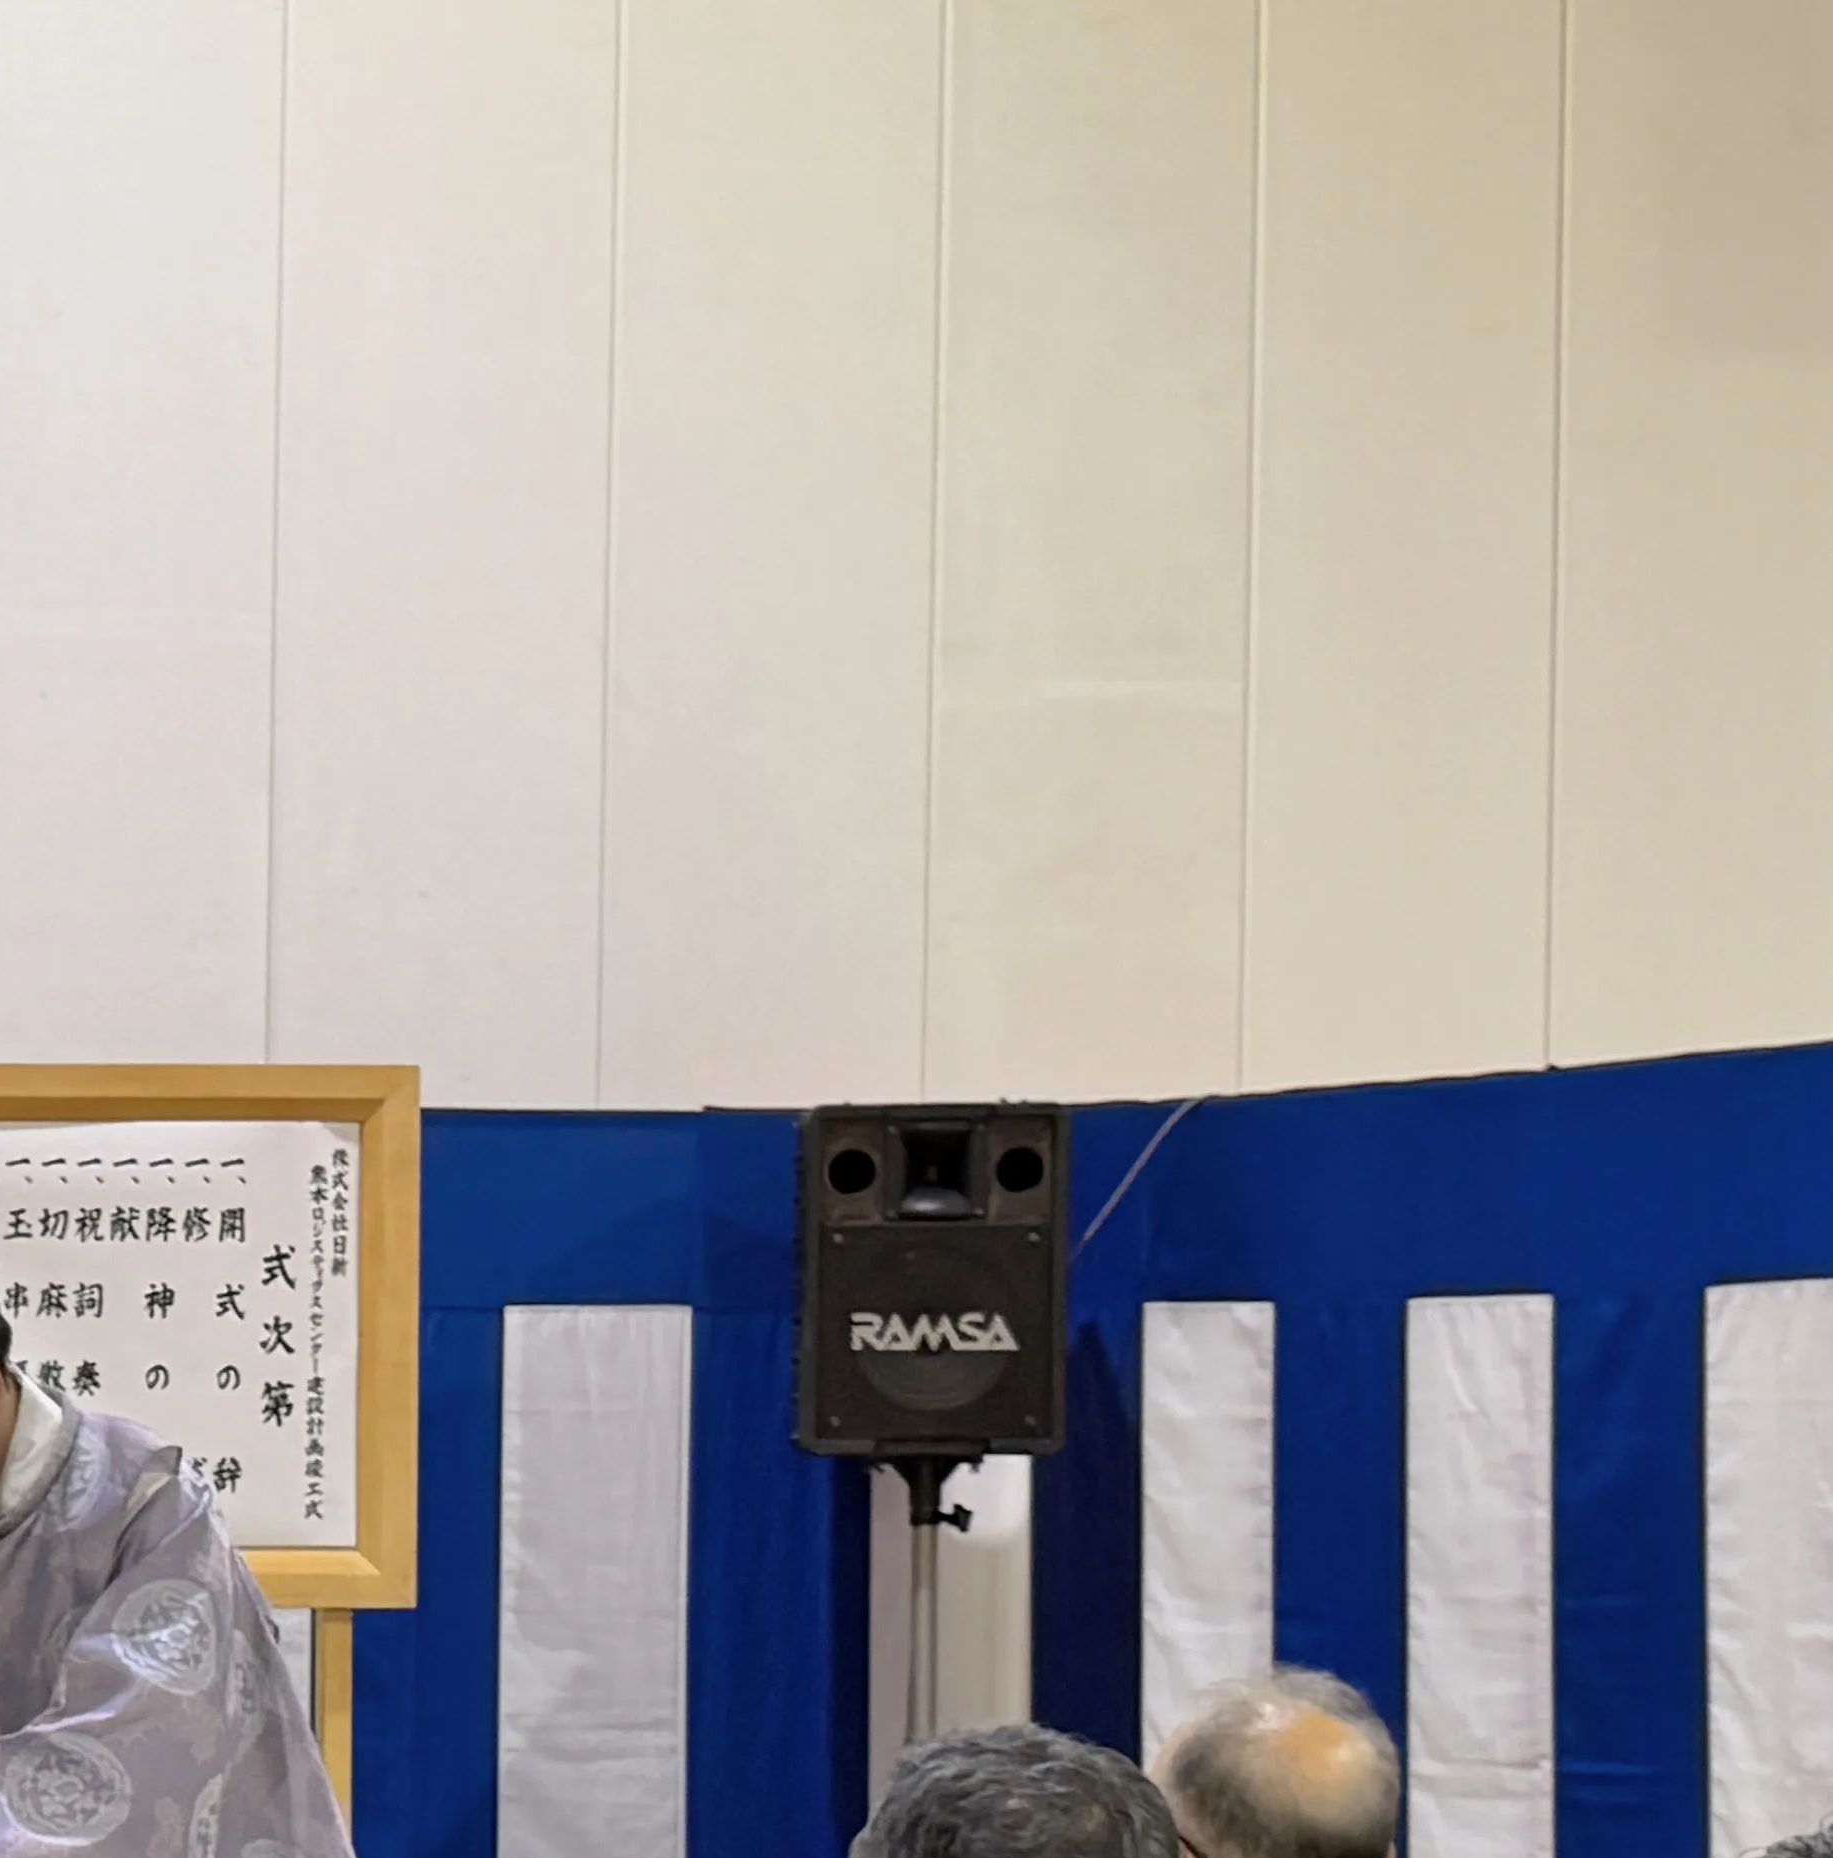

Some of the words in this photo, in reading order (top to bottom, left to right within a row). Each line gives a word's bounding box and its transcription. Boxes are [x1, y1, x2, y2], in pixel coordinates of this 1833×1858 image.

[73, 1157, 106, 1396] 一、祝詞奏
[109, 1157, 141, 1243] 一、献
[144, 1157, 177, 1390] 一、降神の
[261, 1244, 296, 1427] 式次第
[849, 1311, 1020, 1352] RAMSA
